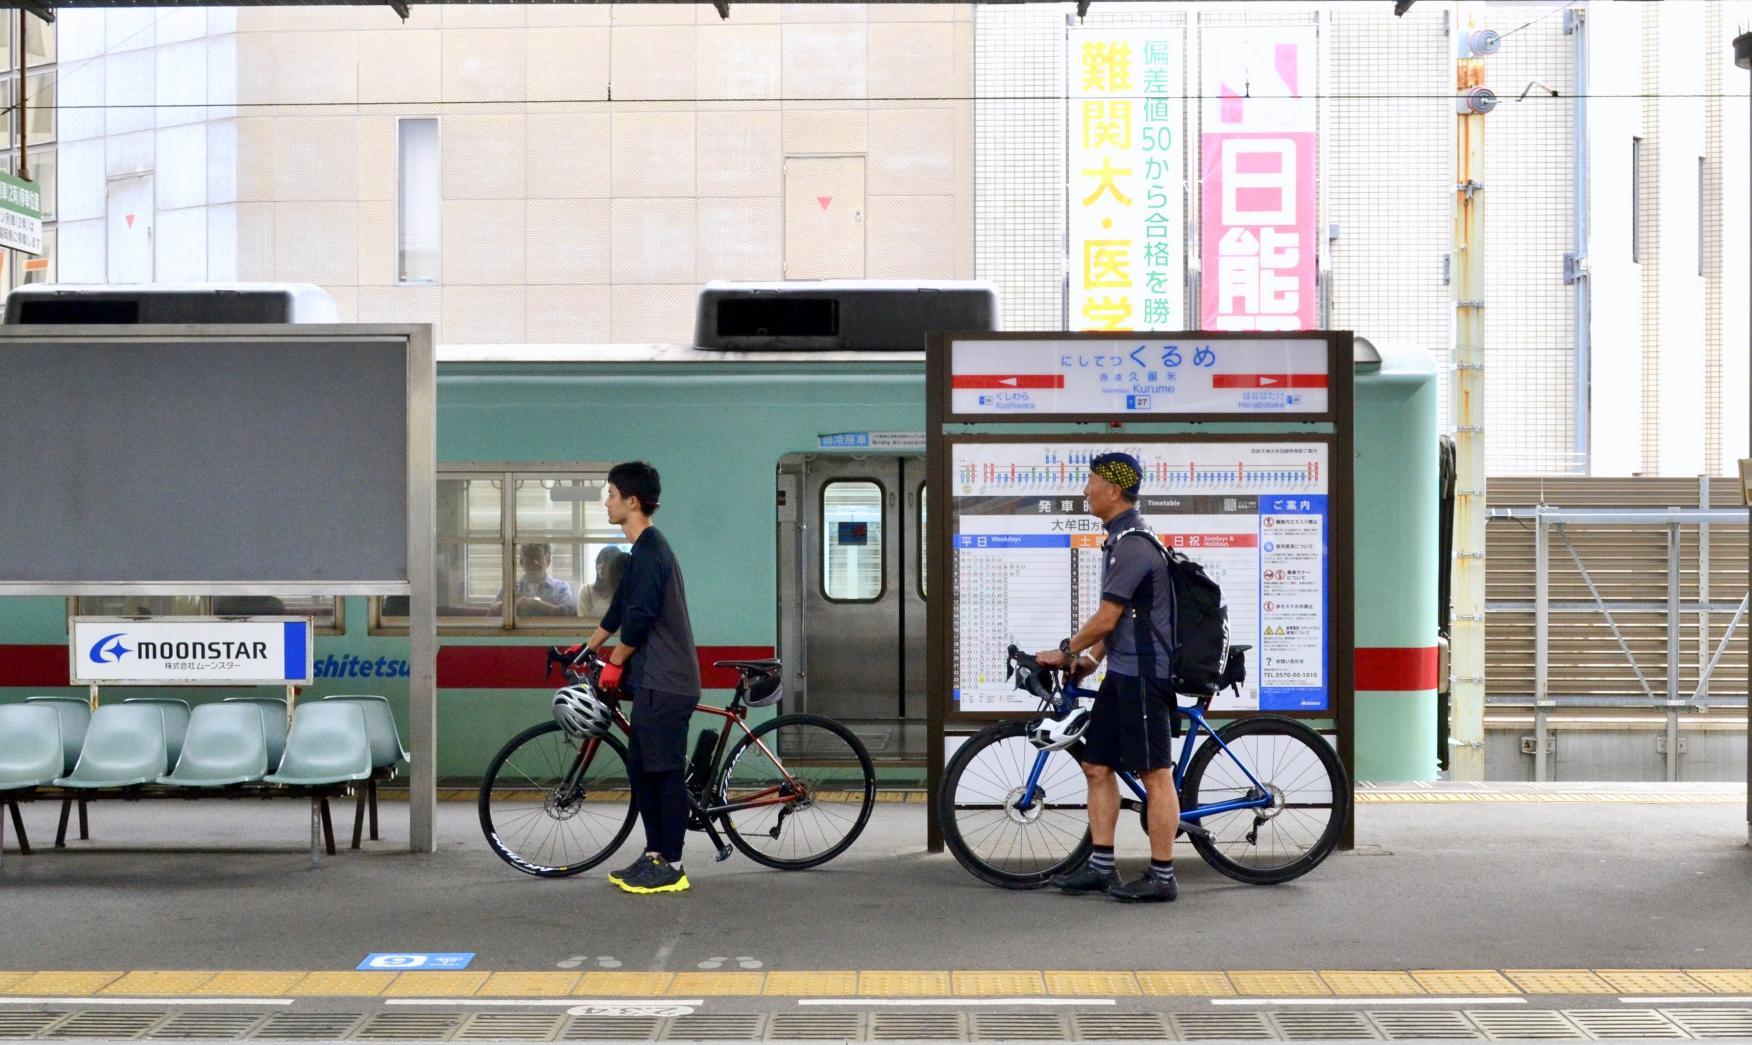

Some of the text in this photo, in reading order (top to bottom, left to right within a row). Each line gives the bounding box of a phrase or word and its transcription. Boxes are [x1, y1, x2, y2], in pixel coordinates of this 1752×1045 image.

[1081, 40, 1133, 331] 難関大・医学
[1141, 39, 1171, 331] 偏差値50から合格を勝
[1133, 383, 1175, 394] Kurume
[996, 391, 1030, 401] くしわら
[1242, 391, 1284, 400] はなばたけ
[996, 401, 1035, 409] Kushiwara
[1137, 398, 1148, 406] 27
[1238, 401, 1285, 409] Hanabatake
[1273, 500, 1311, 510] ご案内
[960, 536, 988, 547] 平日
[1174, 535, 1200, 547] 日祝
[137, 641, 267, 660] MOONSTAR
[165, 661, 241, 670] 株式会社ムーンスター
